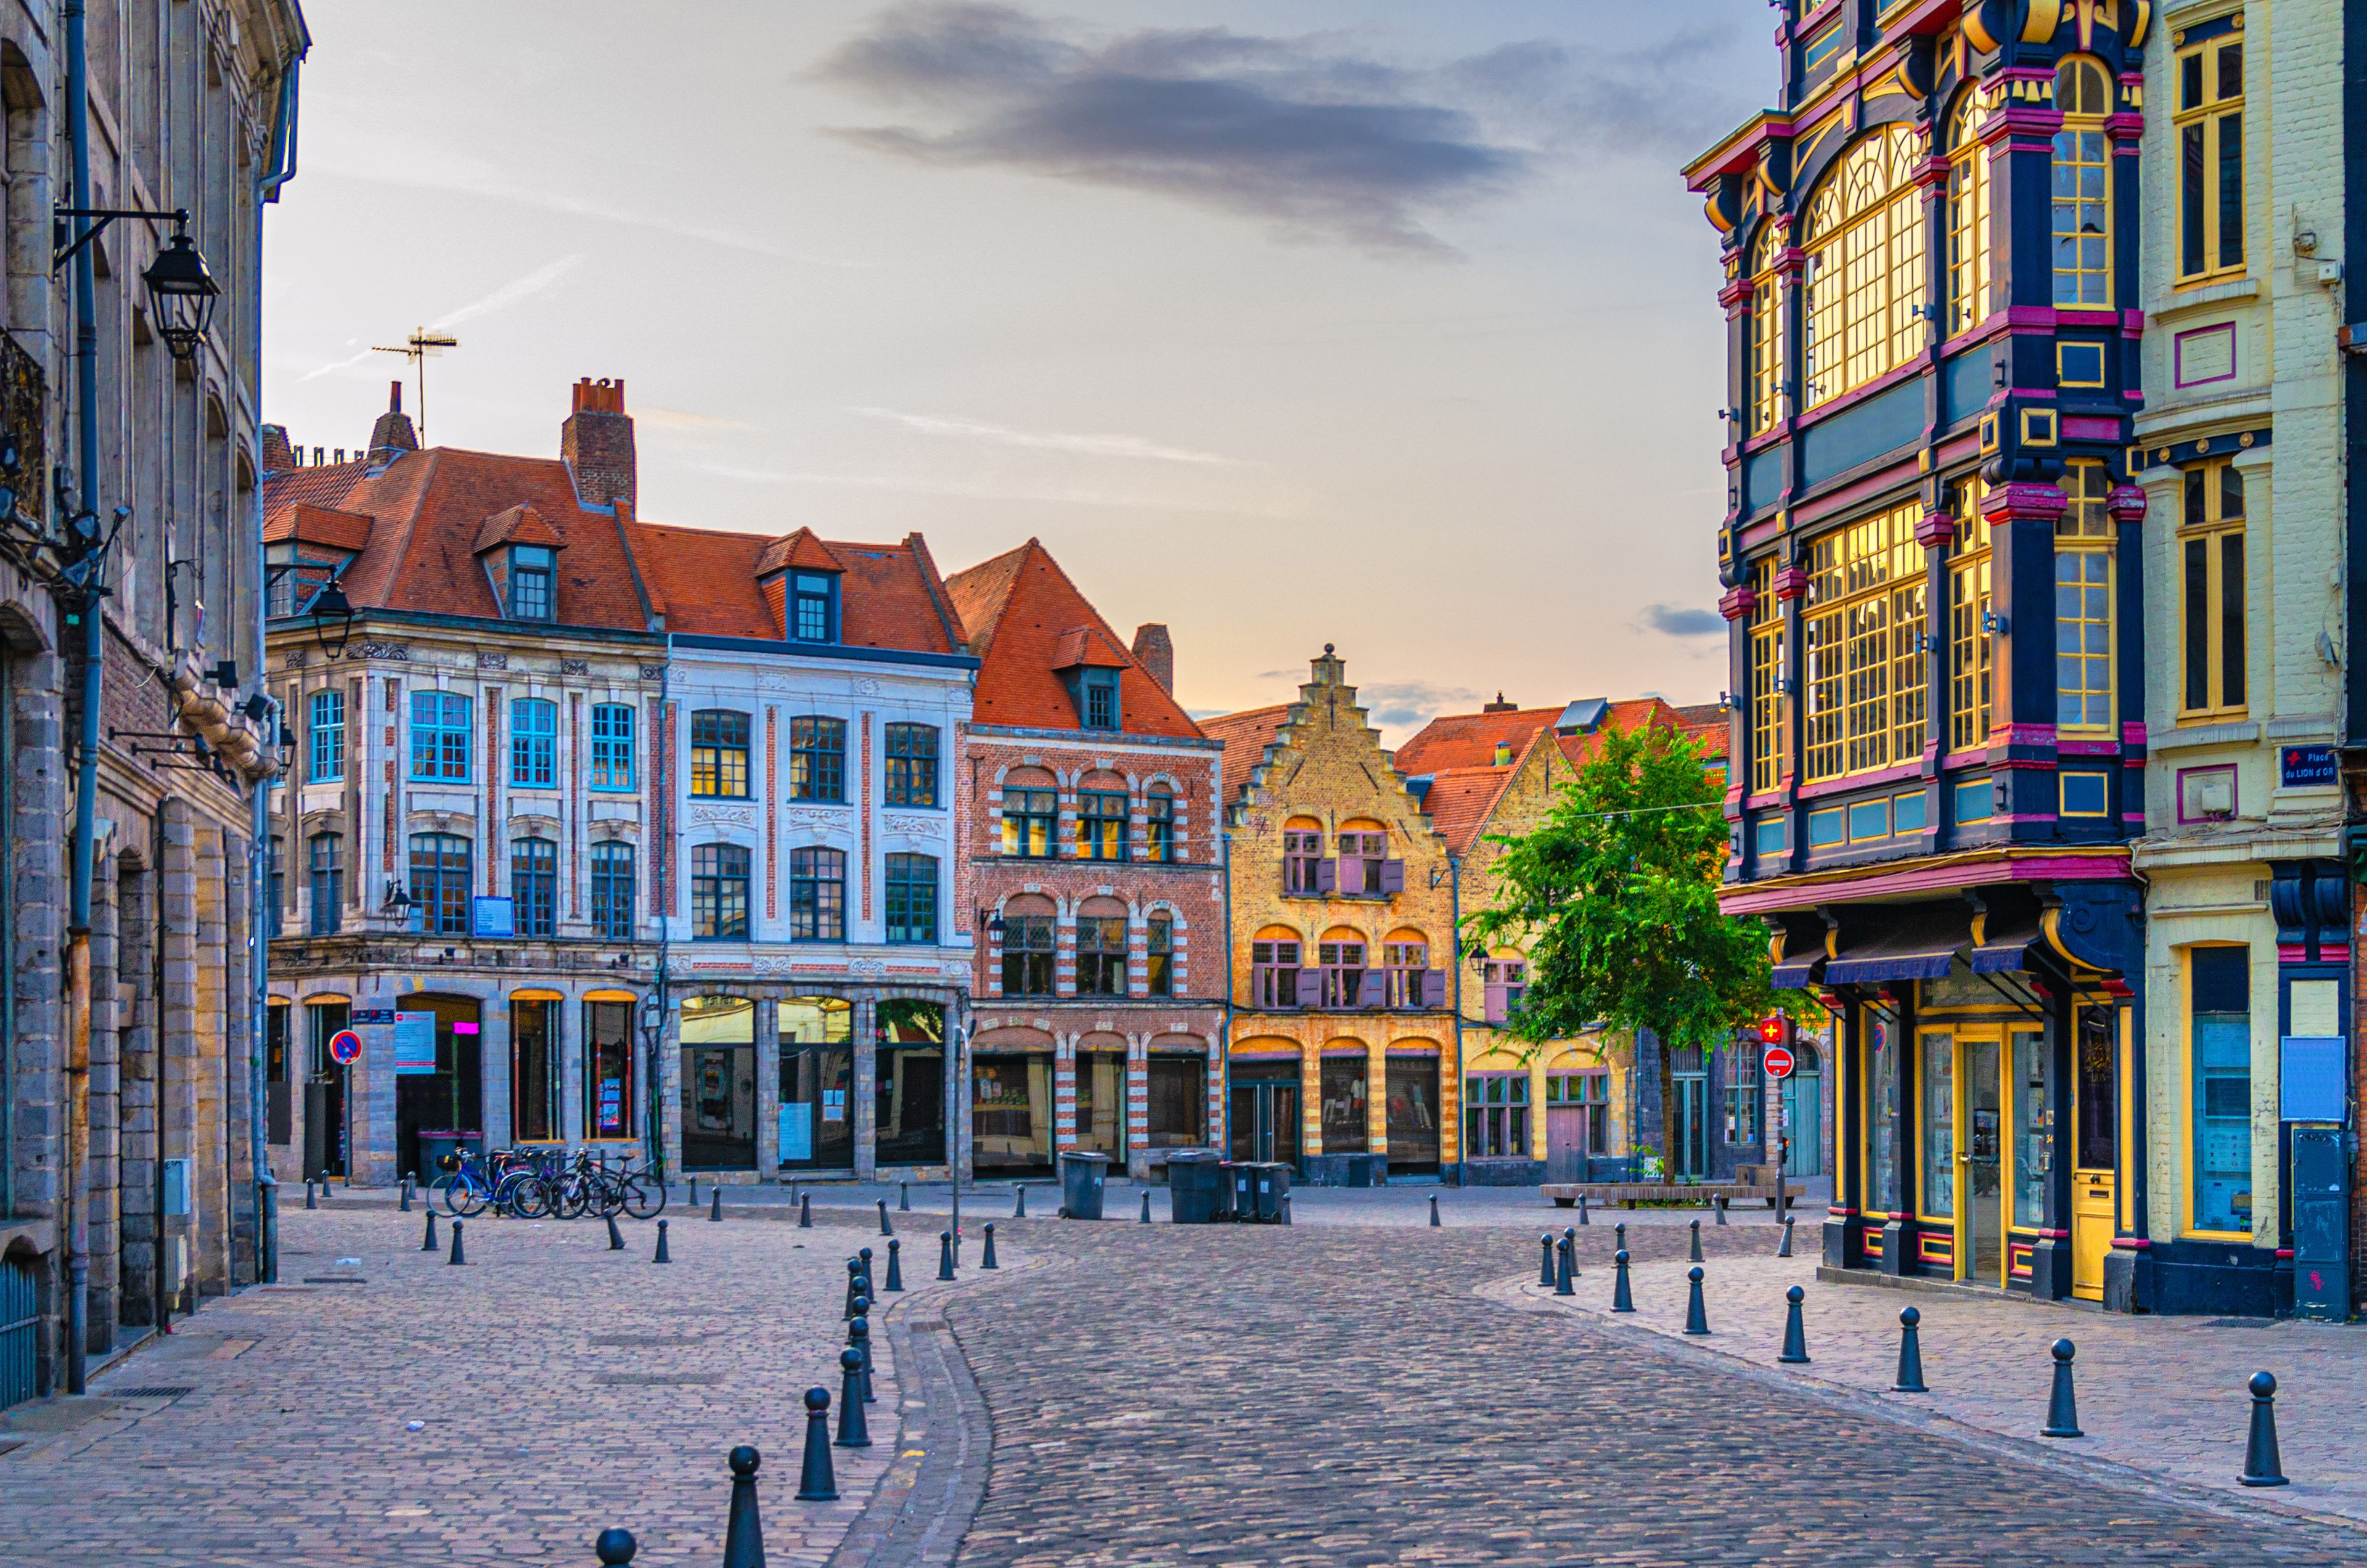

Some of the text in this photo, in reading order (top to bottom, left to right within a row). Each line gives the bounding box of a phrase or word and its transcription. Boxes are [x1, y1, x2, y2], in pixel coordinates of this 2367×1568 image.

[2308, 753, 2329, 762] Place
[2286, 770, 2294, 778] du
[2296, 769, 2313, 778] LION
